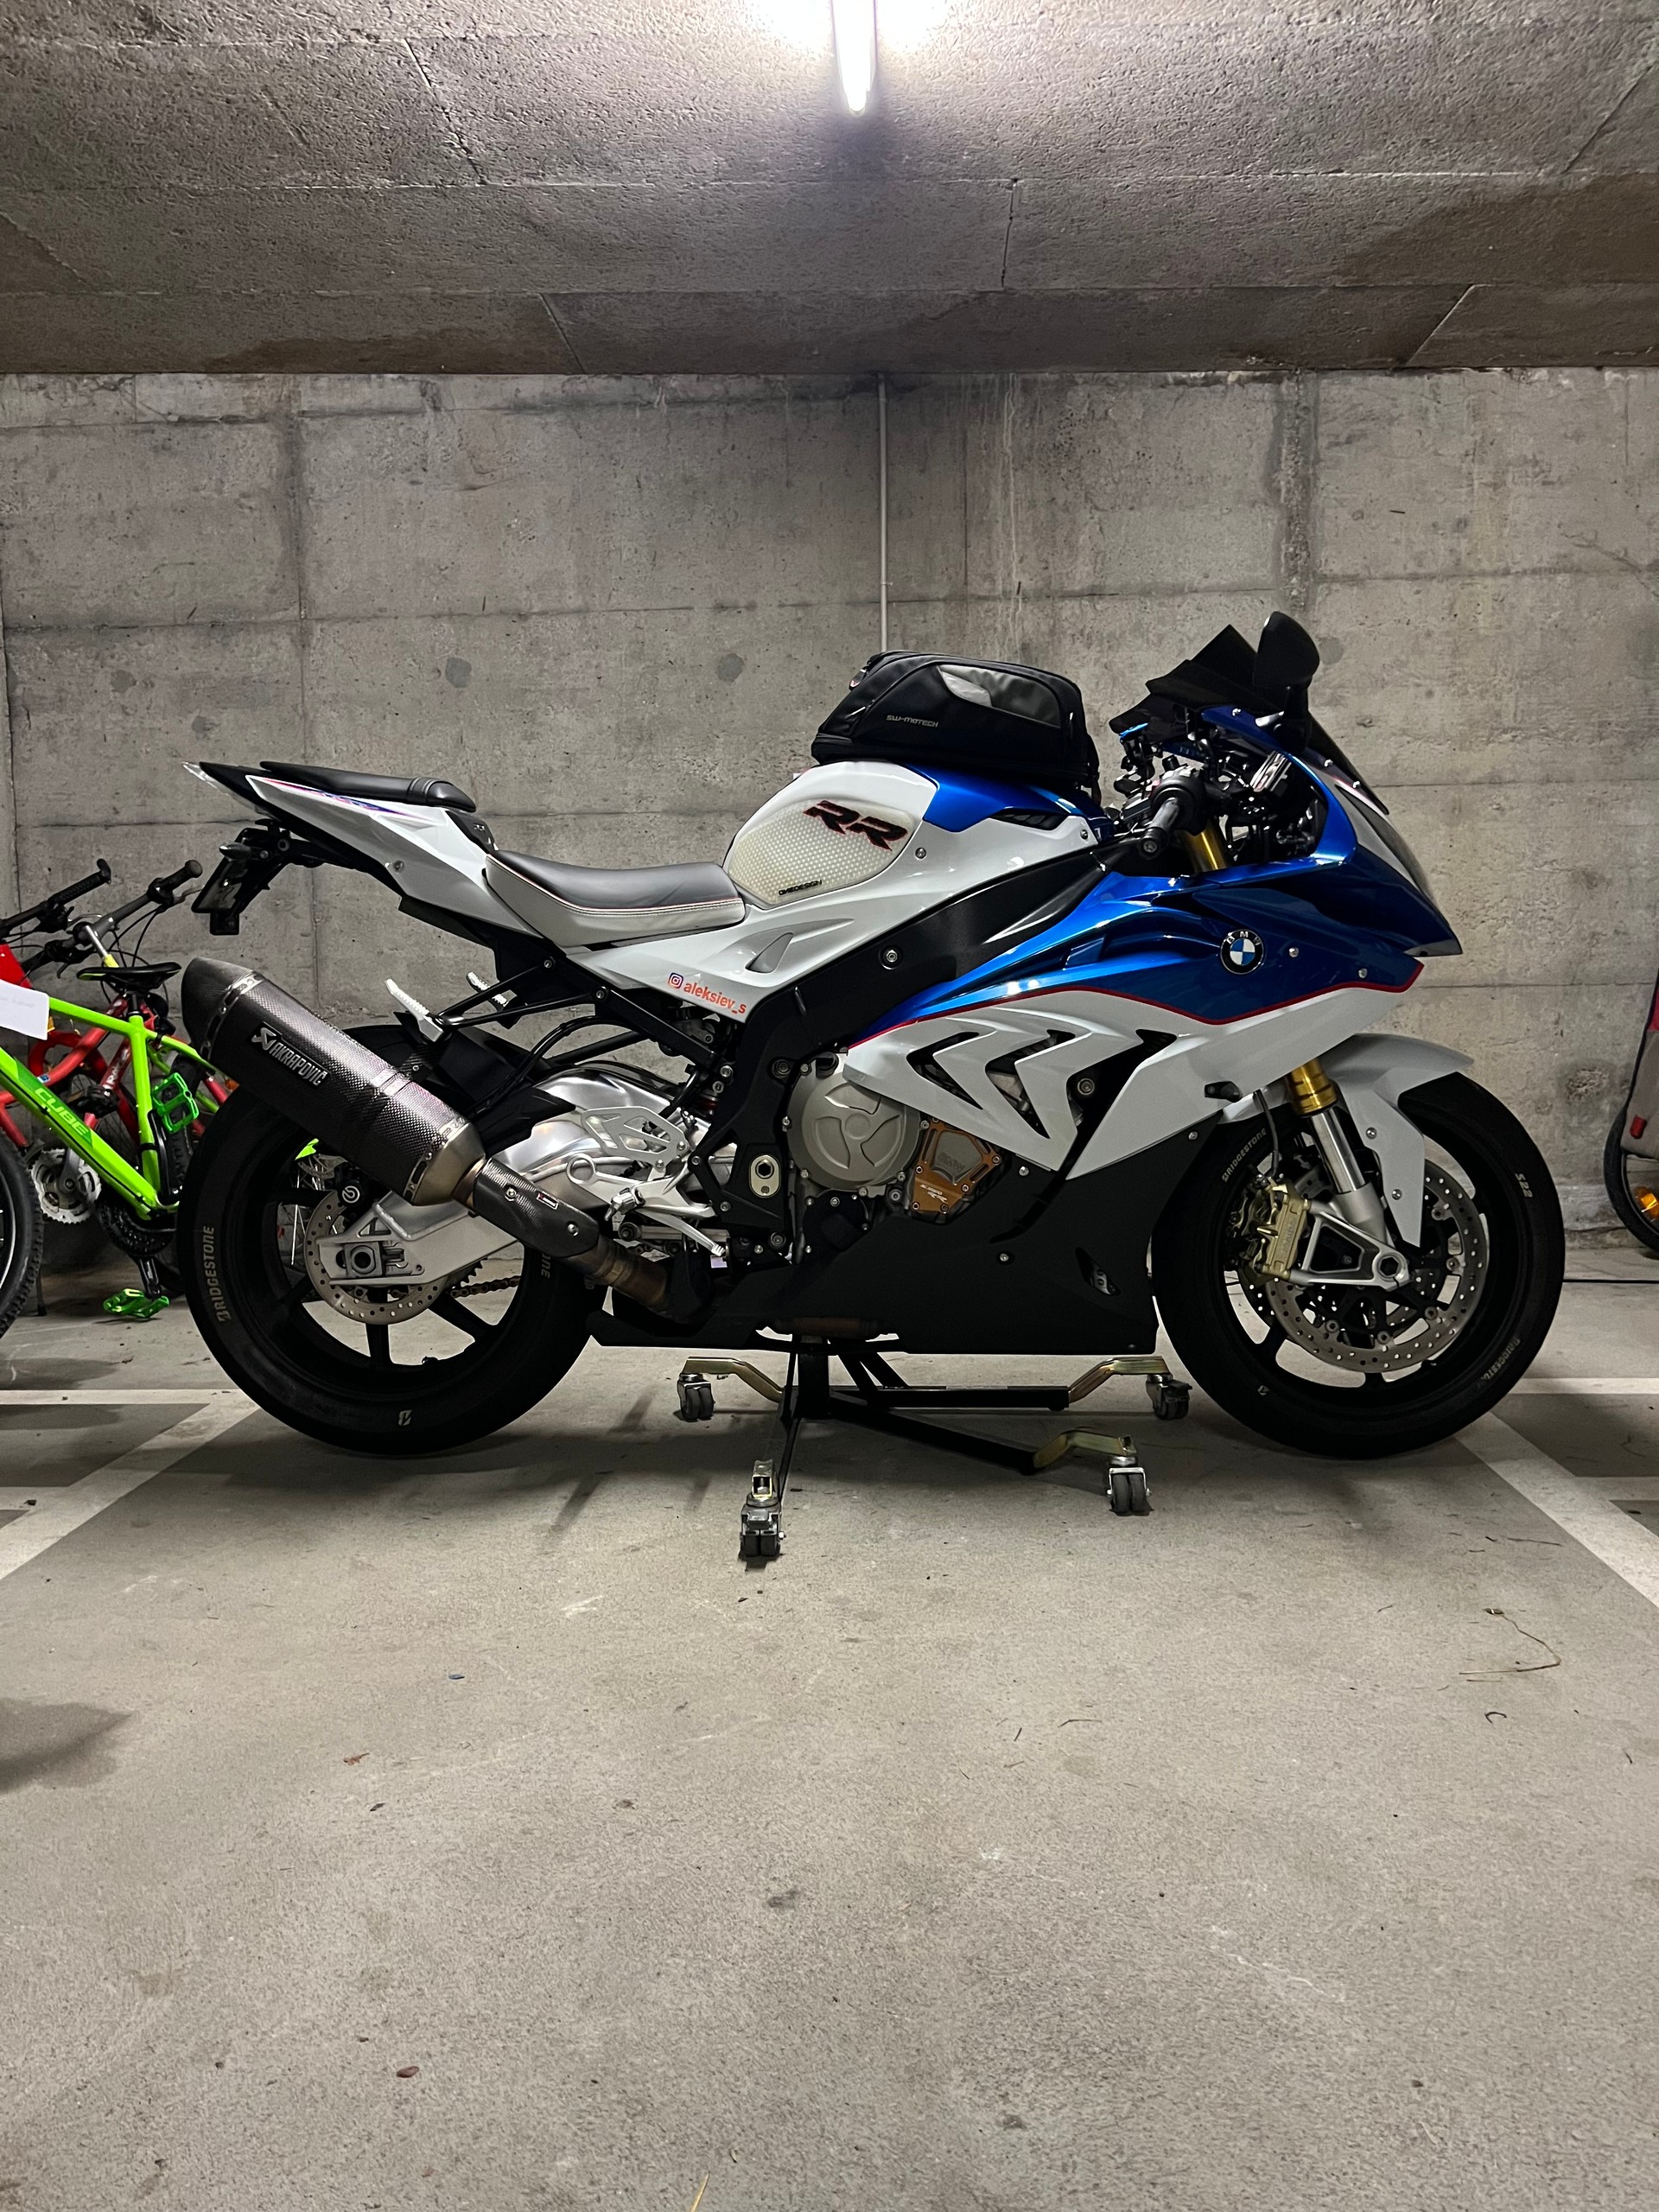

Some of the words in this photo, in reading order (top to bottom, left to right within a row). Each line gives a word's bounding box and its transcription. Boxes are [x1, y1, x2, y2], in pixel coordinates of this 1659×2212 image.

[886, 715, 939, 728] SW-MOTECH
[803, 800, 908, 852] RR
[1226, 931, 1262, 946] BMW
[683, 982, 747, 1014] aleksiev_s
[35, 1088, 89, 1136] CUBE
[1222, 1128, 1268, 1182] BRIDGESTONE
[1515, 1173, 1533, 1198] S22
[202, 1225, 232, 1323] BRIDGESTONE
